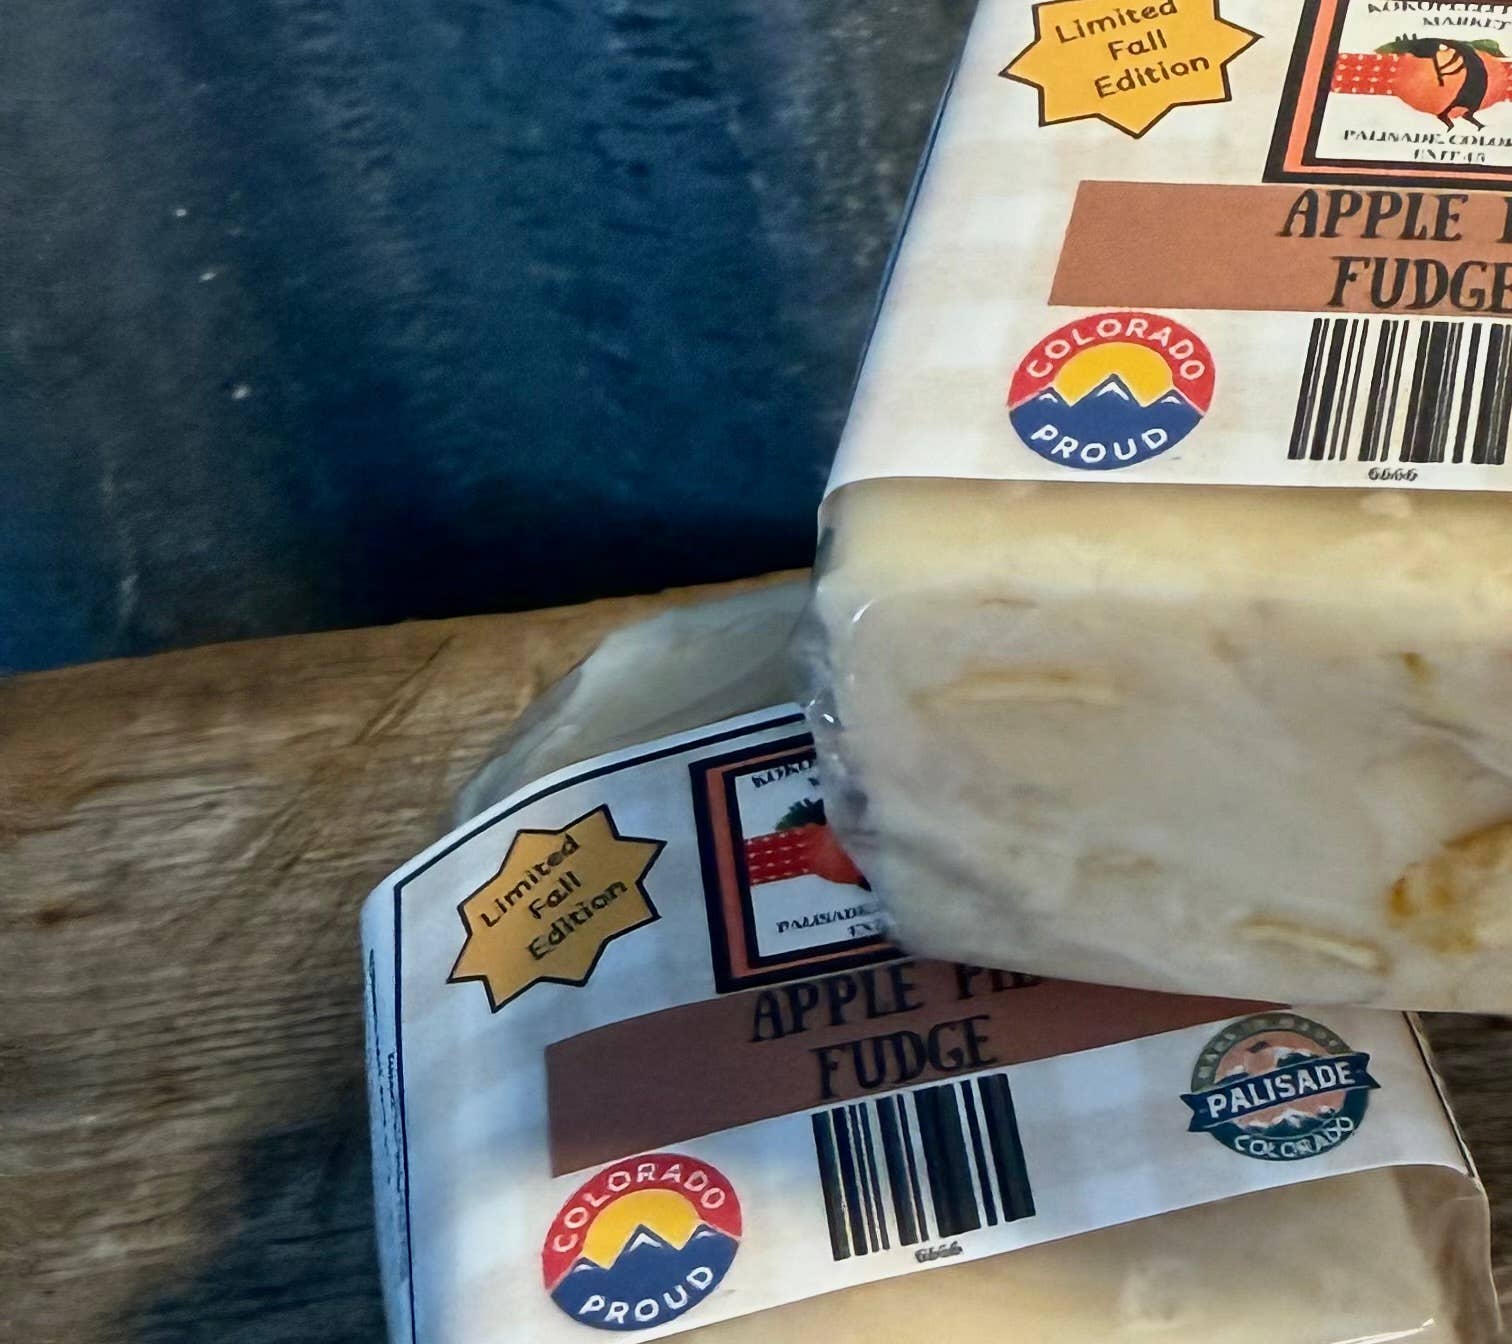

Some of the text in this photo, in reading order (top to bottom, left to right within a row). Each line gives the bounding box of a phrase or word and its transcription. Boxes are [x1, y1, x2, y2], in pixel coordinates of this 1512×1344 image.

[1107, 29, 1168, 60] Fall
[1094, 56, 1210, 98] Edition
[1275, 188, 1469, 242] APPLE
[1026, 318, 1206, 381] COLORADO
[1030, 423, 1169, 464] PROUD
[480, 833, 581, 928] Limited
[528, 870, 582, 920] Fall
[528, 880, 629, 961] Edition
[750, 960, 926, 1043] APPLE
[808, 1014, 998, 1100] FUDGE
[1205, 1061, 1356, 1119] PALISADE
[1234, 1116, 1355, 1159] COLORADO
[552, 1162, 727, 1253] COLORADO
[577, 1266, 714, 1325] PROUD
